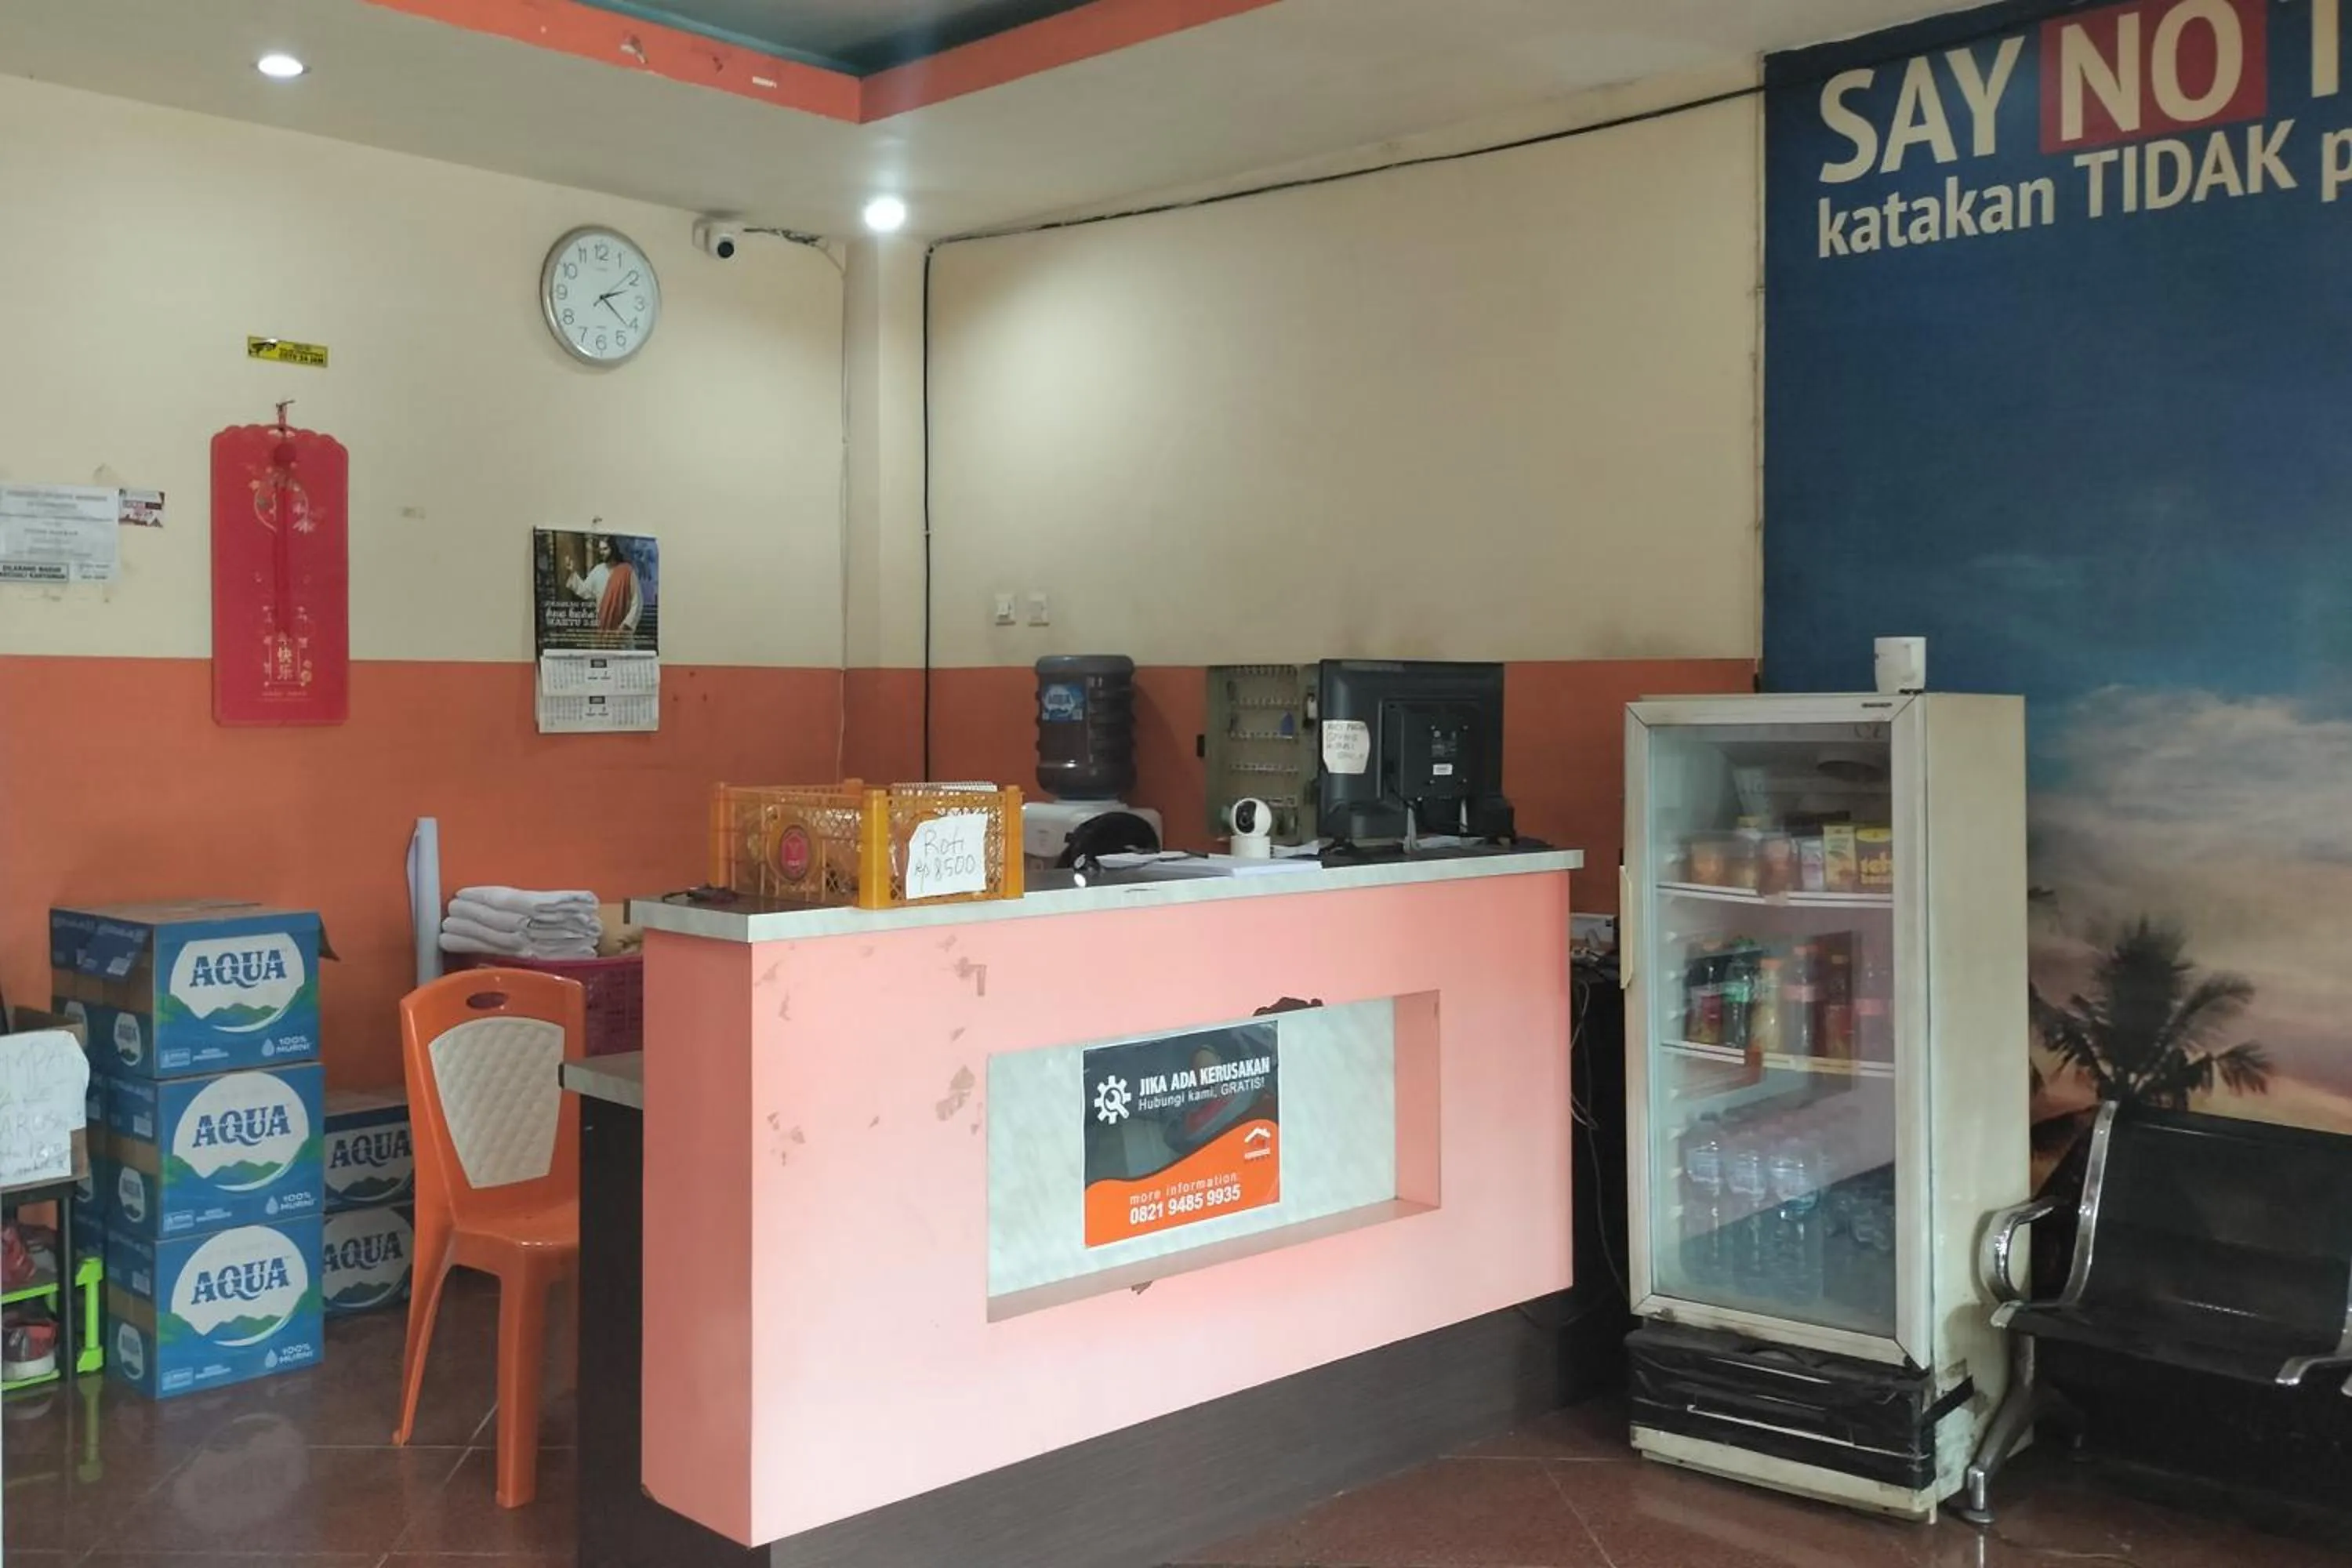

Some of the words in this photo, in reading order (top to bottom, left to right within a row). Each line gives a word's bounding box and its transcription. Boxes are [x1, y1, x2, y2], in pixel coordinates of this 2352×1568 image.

[1819, 36, 2026, 183] SAY
[2060, 0, 2243, 142] NO
[1818, 176, 2055, 258] katakan
[2074, 119, 2298, 218] TIDAK
[578, 248, 587, 263] 11
[593, 244, 609, 261] 12
[617, 252, 622, 268] 1
[563, 263, 578, 280] 10
[628, 270, 639, 287] 2
[557, 284, 568, 300] 9
[634, 296, 645, 312] 3
[562, 308, 575, 325] 8
[629, 317, 639, 332] 4
[578, 326, 588, 342] 7
[595, 334, 607, 350] 6
[616, 330, 626, 347] 5
[189, 949, 287, 989] AQUA
[1139, 1075, 1167, 1096] JIKA
[1171, 1070, 1197, 1091] ADA
[1200, 1057, 1270, 1085] KERUSAKAN
[1138, 1091, 1185, 1111] Hubungi
[192, 1105, 291, 1148] AQUA
[328, 1129, 412, 1169] AQUA
[1130, 1189, 1161, 1204] more
[1166, 1172, 1236, 1196] information
[1130, 1201, 1163, 1225] 0821
[1167, 1192, 1203, 1215] 9485
[1206, 1184, 1241, 1206] 9935
[323, 1232, 404, 1272] AQUA
[191, 1258, 290, 1305] AQUA
